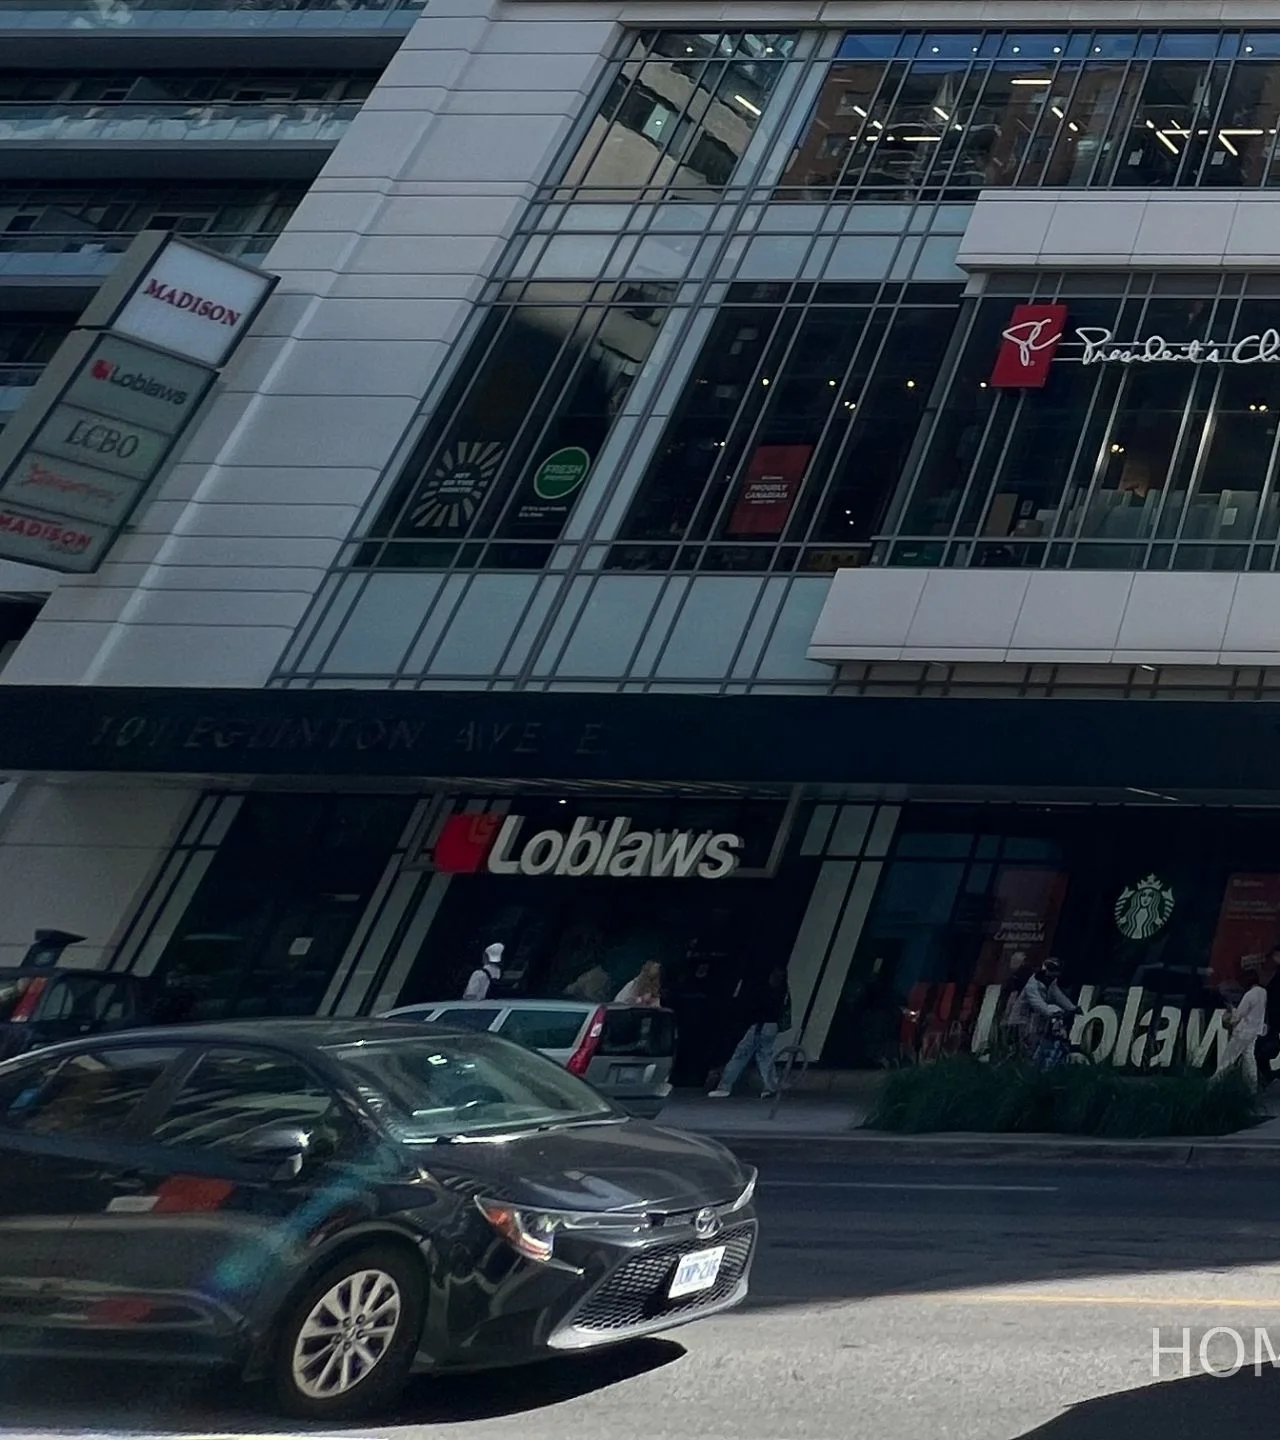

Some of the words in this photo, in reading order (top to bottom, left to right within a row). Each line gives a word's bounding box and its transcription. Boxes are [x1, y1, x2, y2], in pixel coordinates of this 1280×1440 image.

[143, 278, 243, 328] MADISON
[1075, 326, 1219, 366] President's
[108, 363, 189, 407] Loblaws
[64, 420, 139, 460] LCBO
[0, 514, 93, 547] MADISON
[455, 720, 542, 754] AVE
[575, 722, 608, 755] E
[487, 814, 745, 877] Loblaws
